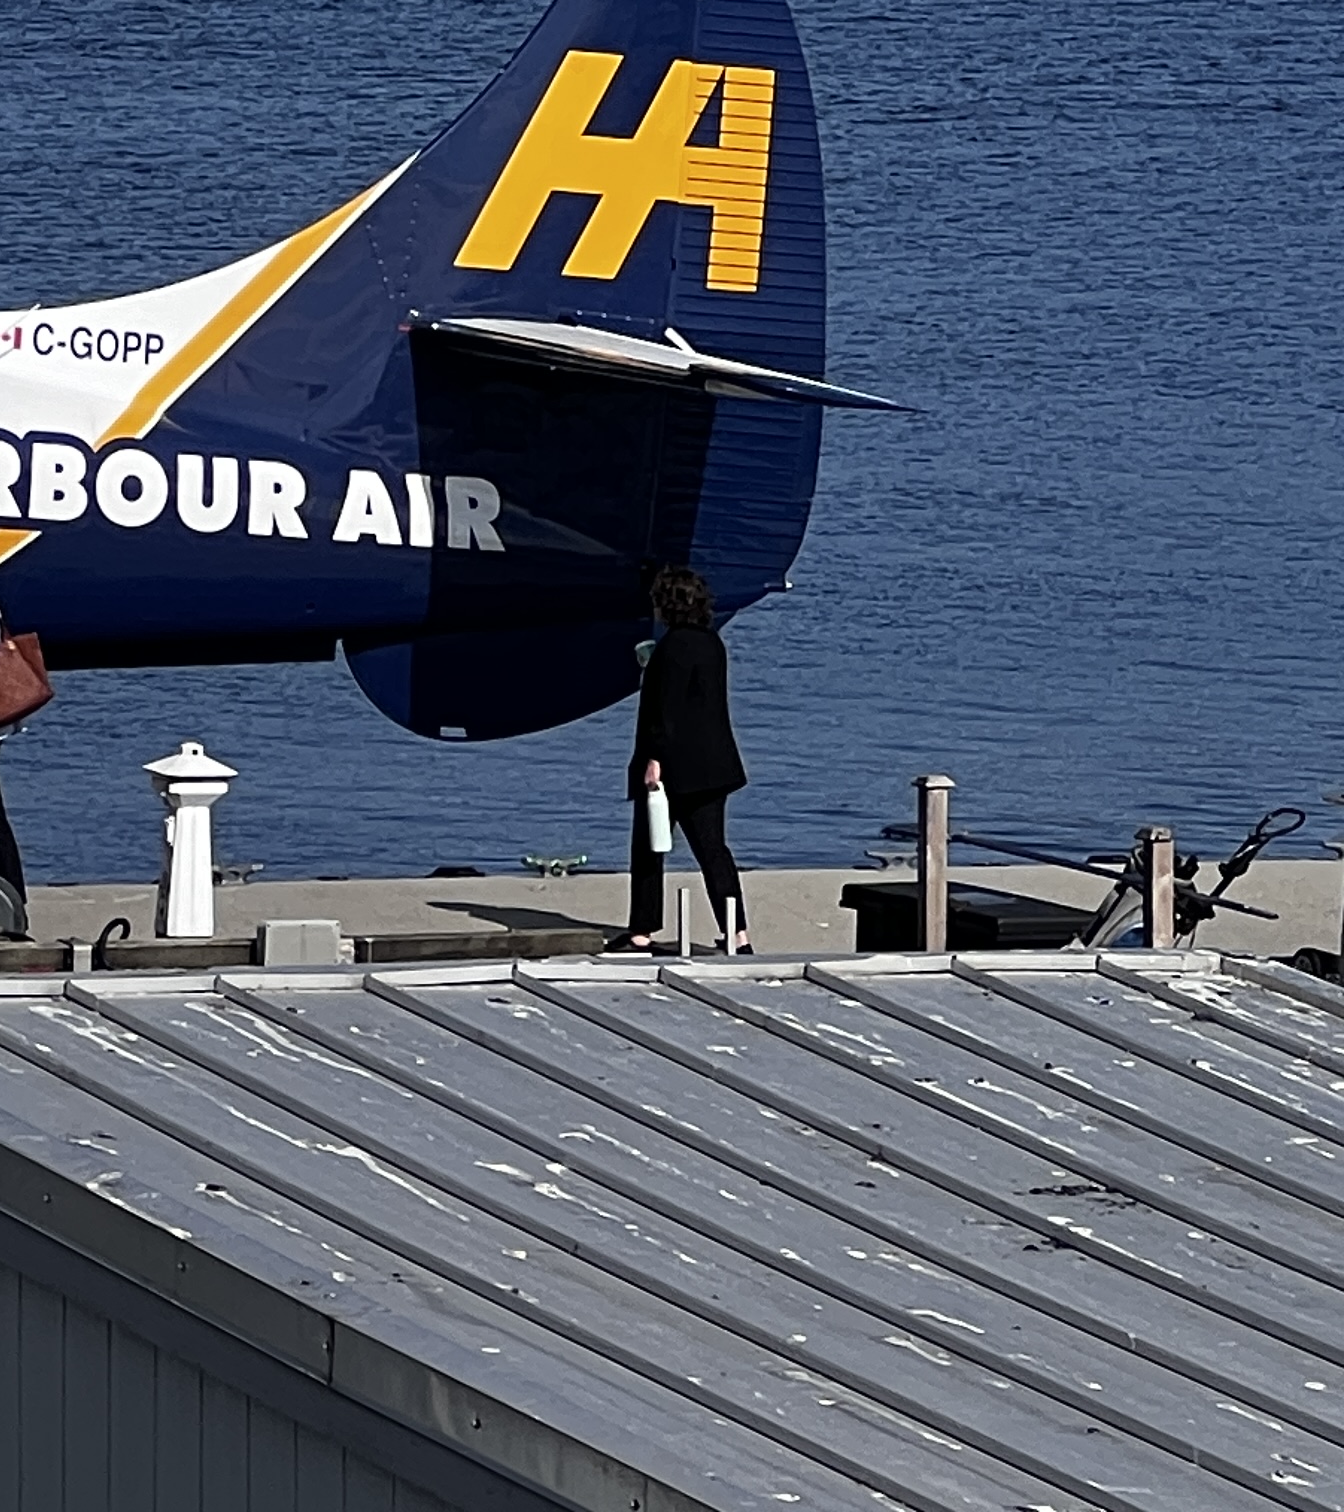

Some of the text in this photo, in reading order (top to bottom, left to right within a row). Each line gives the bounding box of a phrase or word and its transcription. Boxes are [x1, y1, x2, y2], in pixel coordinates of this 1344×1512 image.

[454, 50, 776, 292] HA
[32, 322, 164, 365] C-GOPP
[332, 469, 506, 552] AIR
